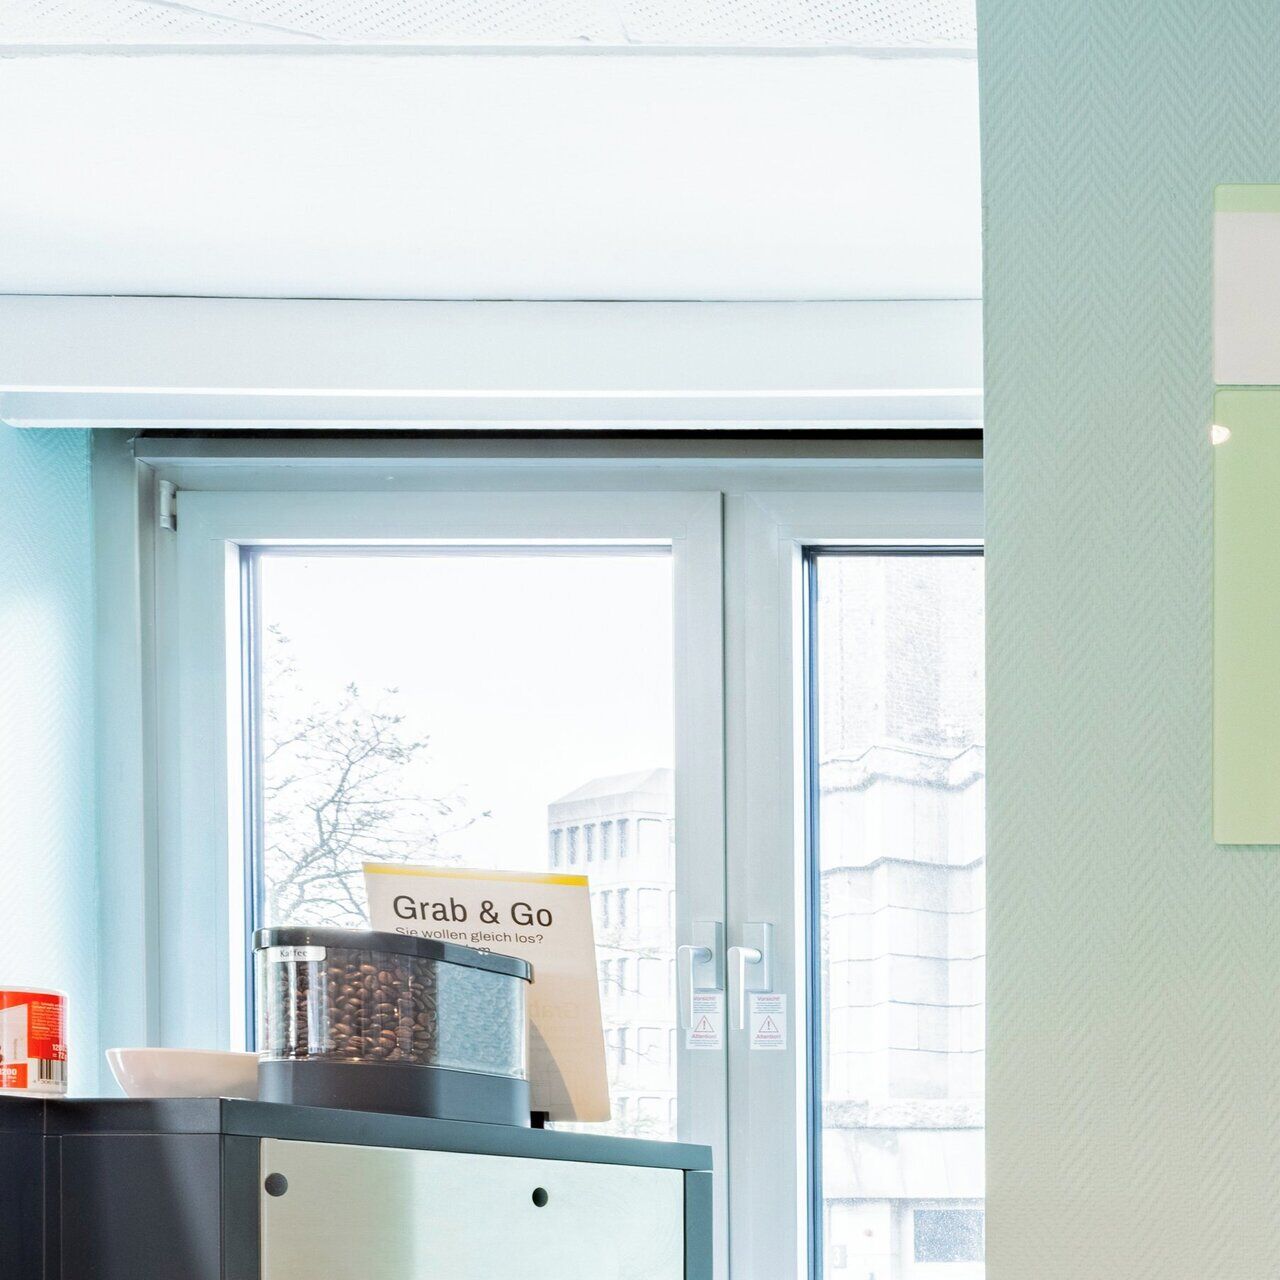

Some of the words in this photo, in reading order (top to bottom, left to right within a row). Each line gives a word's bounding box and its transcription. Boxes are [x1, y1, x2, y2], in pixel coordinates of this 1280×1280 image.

[393, 895, 468, 923] Grab
[479, 900, 500, 925] &
[511, 902, 553, 927] Go
[421, 929, 467, 940] wollen
[470, 931, 512, 943] gleich
[515, 933, 544, 944] los?
[281, 949, 308, 957] Kafee
